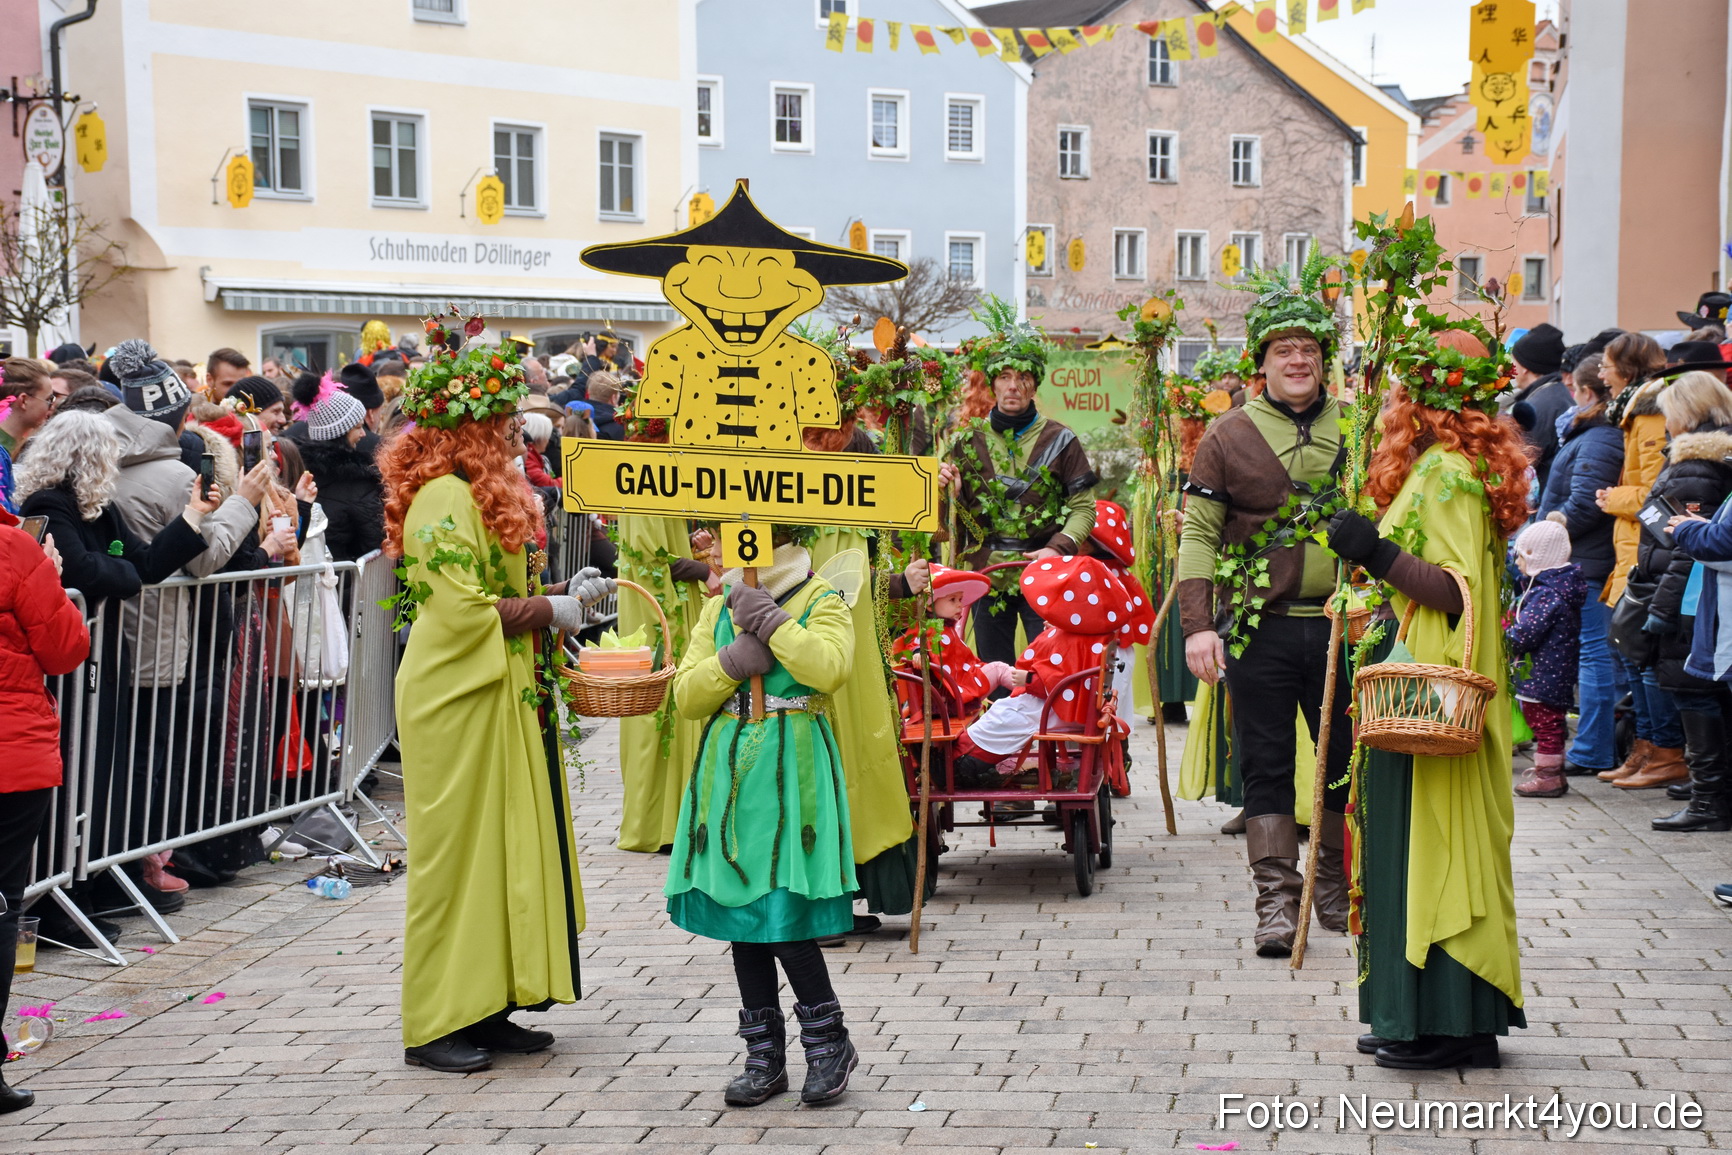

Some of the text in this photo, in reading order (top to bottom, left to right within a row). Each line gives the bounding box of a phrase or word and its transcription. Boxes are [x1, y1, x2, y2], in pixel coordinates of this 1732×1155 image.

[1477, 48, 1492, 64] 人
[369, 236, 552, 271] Schuhmoden Döllinger
[1050, 367, 1102, 388] GAUDI
[1062, 391, 1110, 413] WEIDI
[615, 461, 877, 508] GAU-DI-WEI-DIE
[737, 529, 760, 562] 8
